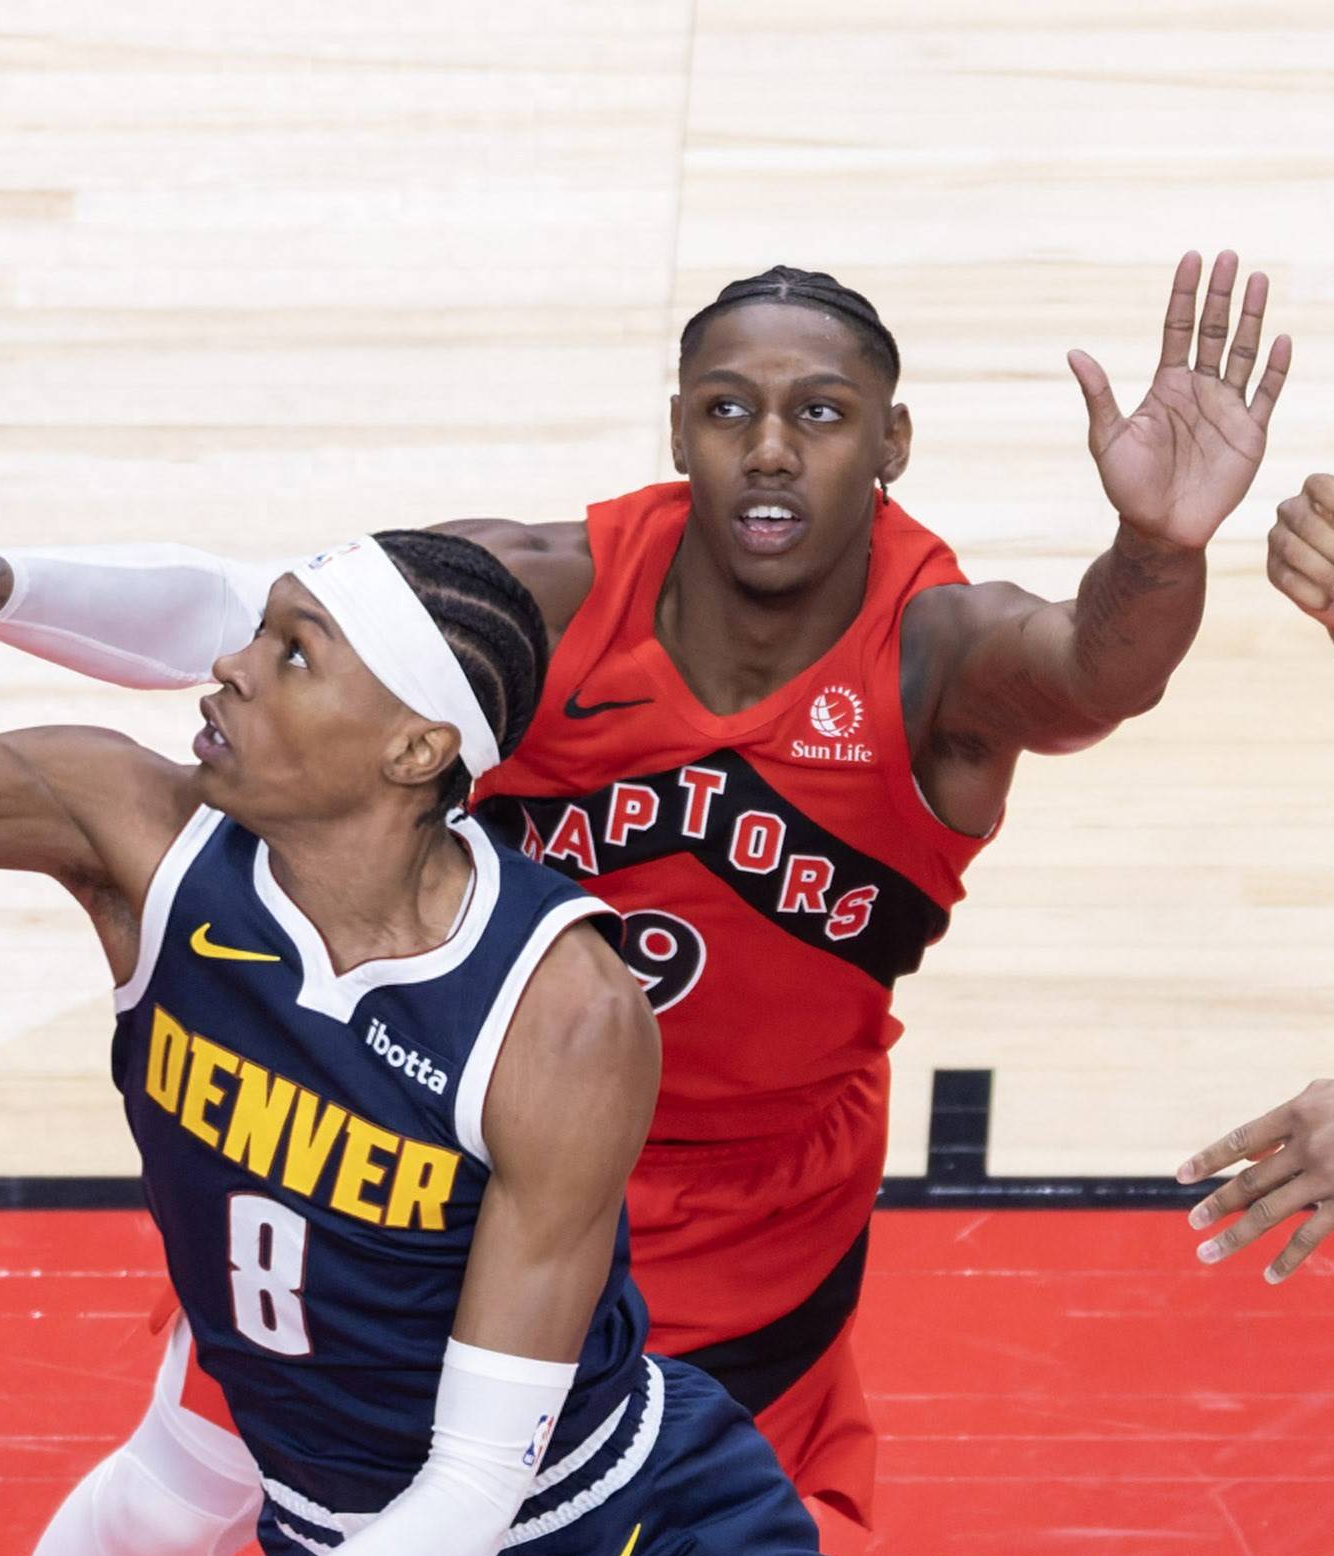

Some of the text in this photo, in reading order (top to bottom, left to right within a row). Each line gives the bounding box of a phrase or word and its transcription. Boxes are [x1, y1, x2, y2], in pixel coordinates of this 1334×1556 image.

[791, 739, 873, 763] Sun Life
[144, 1001, 462, 1232] DENVER
[366, 1018, 449, 1095] ibotta
[227, 1191, 314, 1357] 8
